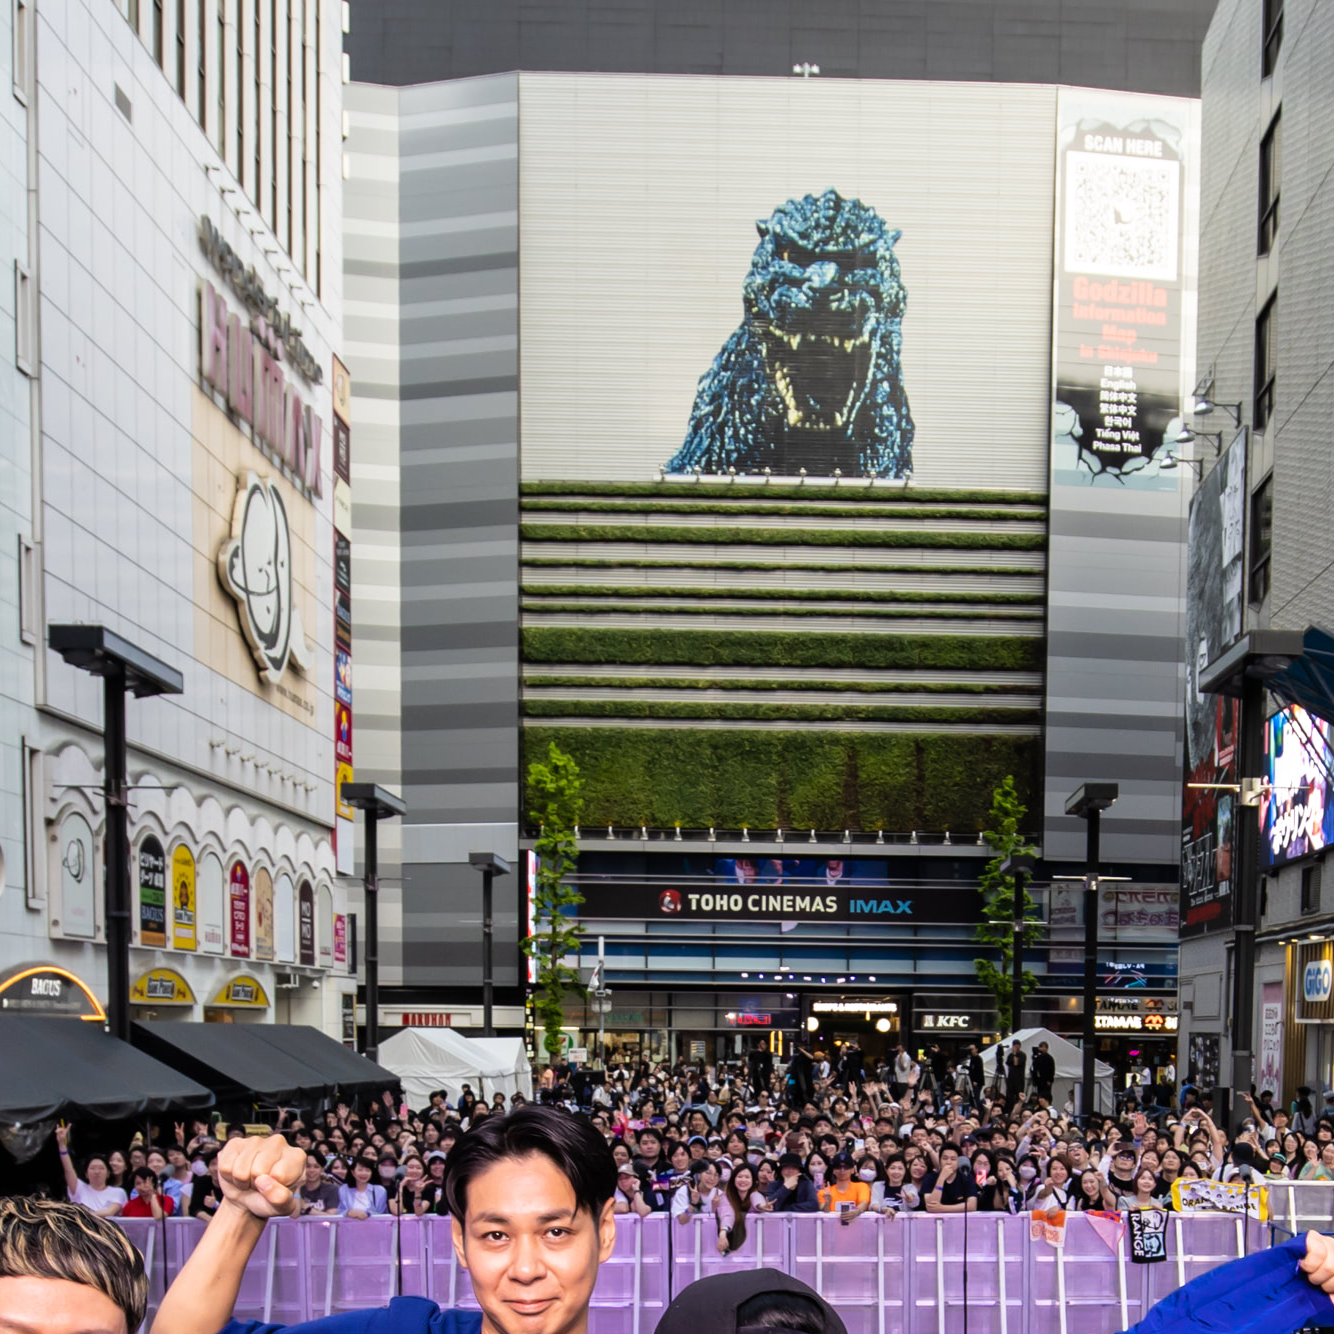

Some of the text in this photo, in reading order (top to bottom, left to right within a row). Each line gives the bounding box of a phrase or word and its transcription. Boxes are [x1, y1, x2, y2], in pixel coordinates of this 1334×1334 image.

[1084, 134, 1163, 157] SCAN HERE
[1073, 276, 1167, 307] Godzilla
[1073, 302, 1166, 326] Information
[1100, 378, 1136, 391] English
[1104, 415, 1132, 428] 한국어
[1093, 441, 1142, 453] Phasa Thai
[688, 894, 913, 914] TOHO CINEMAS IMAX
[31, 978, 62, 996] BAGUS
[402, 1012, 451, 1026] MARUHAN
[936, 1014, 969, 1028] KFC
[1130, 1213, 1145, 1257] RANGE
